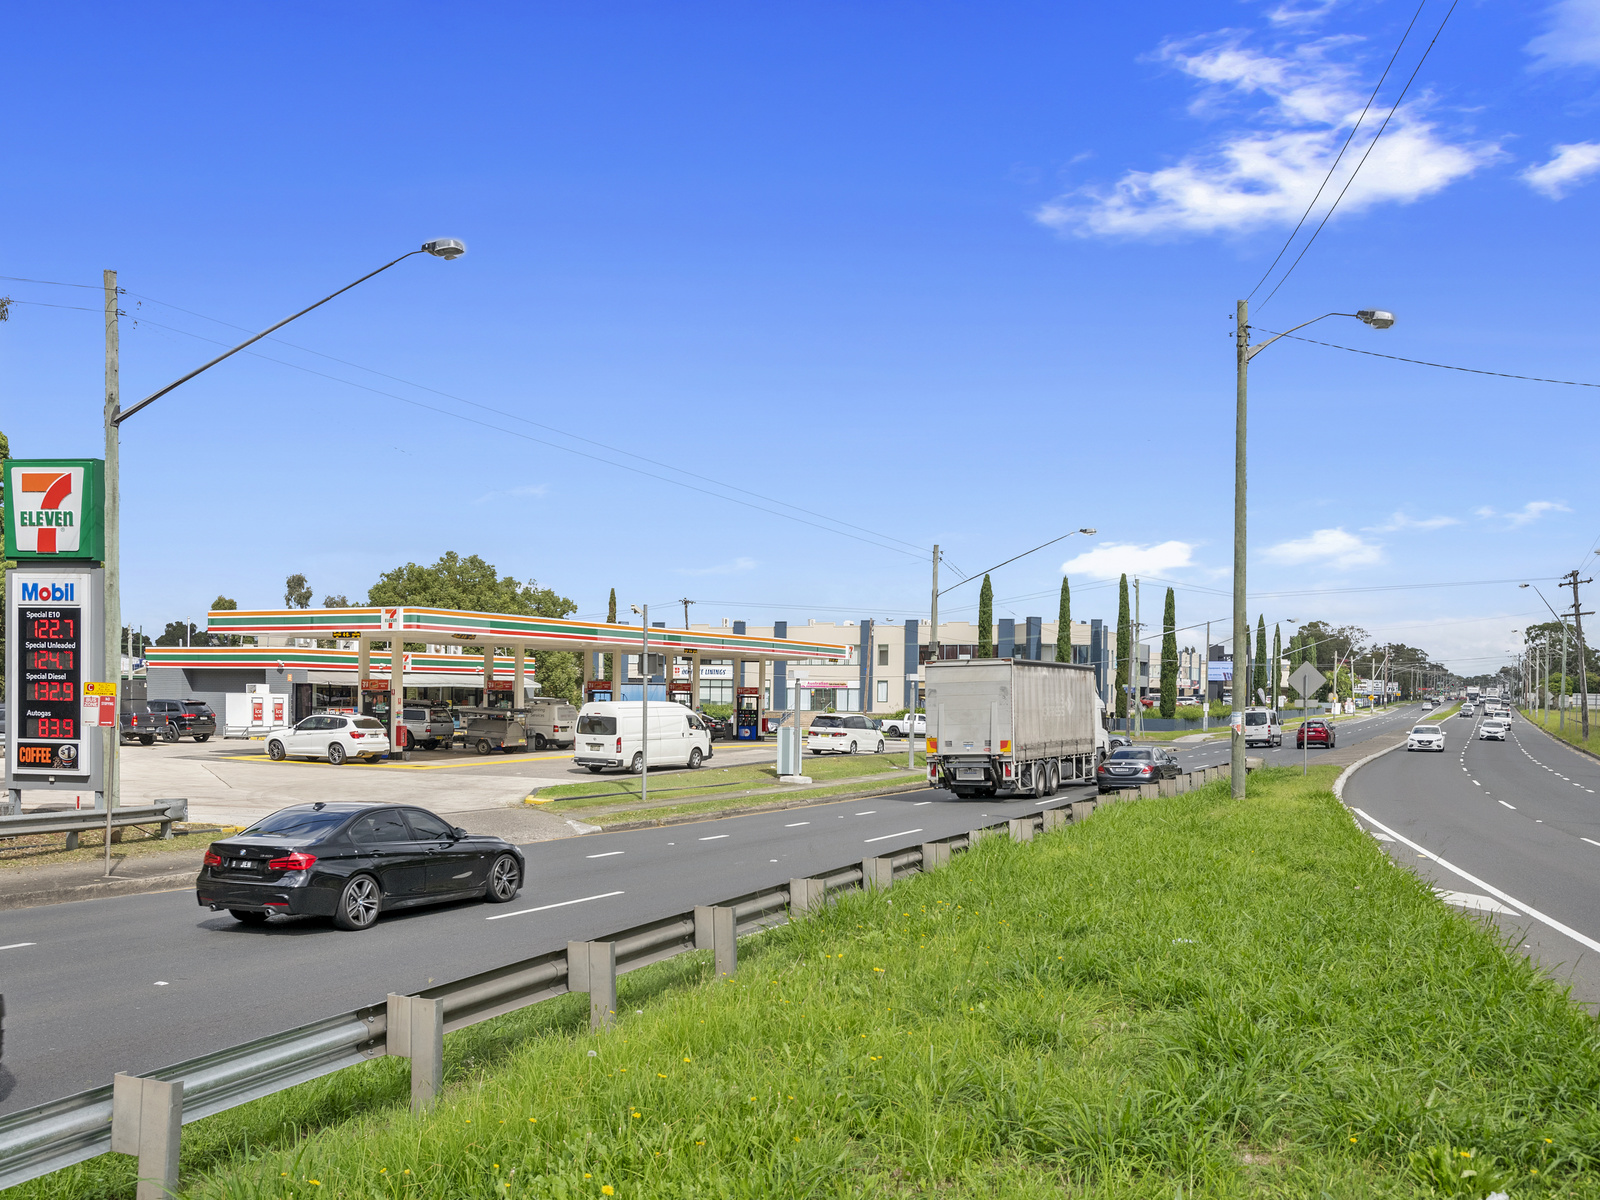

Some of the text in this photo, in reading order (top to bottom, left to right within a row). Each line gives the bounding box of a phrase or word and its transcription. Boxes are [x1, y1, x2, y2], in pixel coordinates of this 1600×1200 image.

[22, 472, 72, 553] 7
[22, 583, 74, 601] Mobil
[26, 611, 47, 619] Special
[34, 619, 74, 639] 122.7
[34, 650, 73, 669] 124.7
[34, 682, 74, 701] 132.9
[26, 710, 51, 718] Autogas
[38, 719, 74, 738] 83.9
[19, 746, 51, 763] COFFEE
